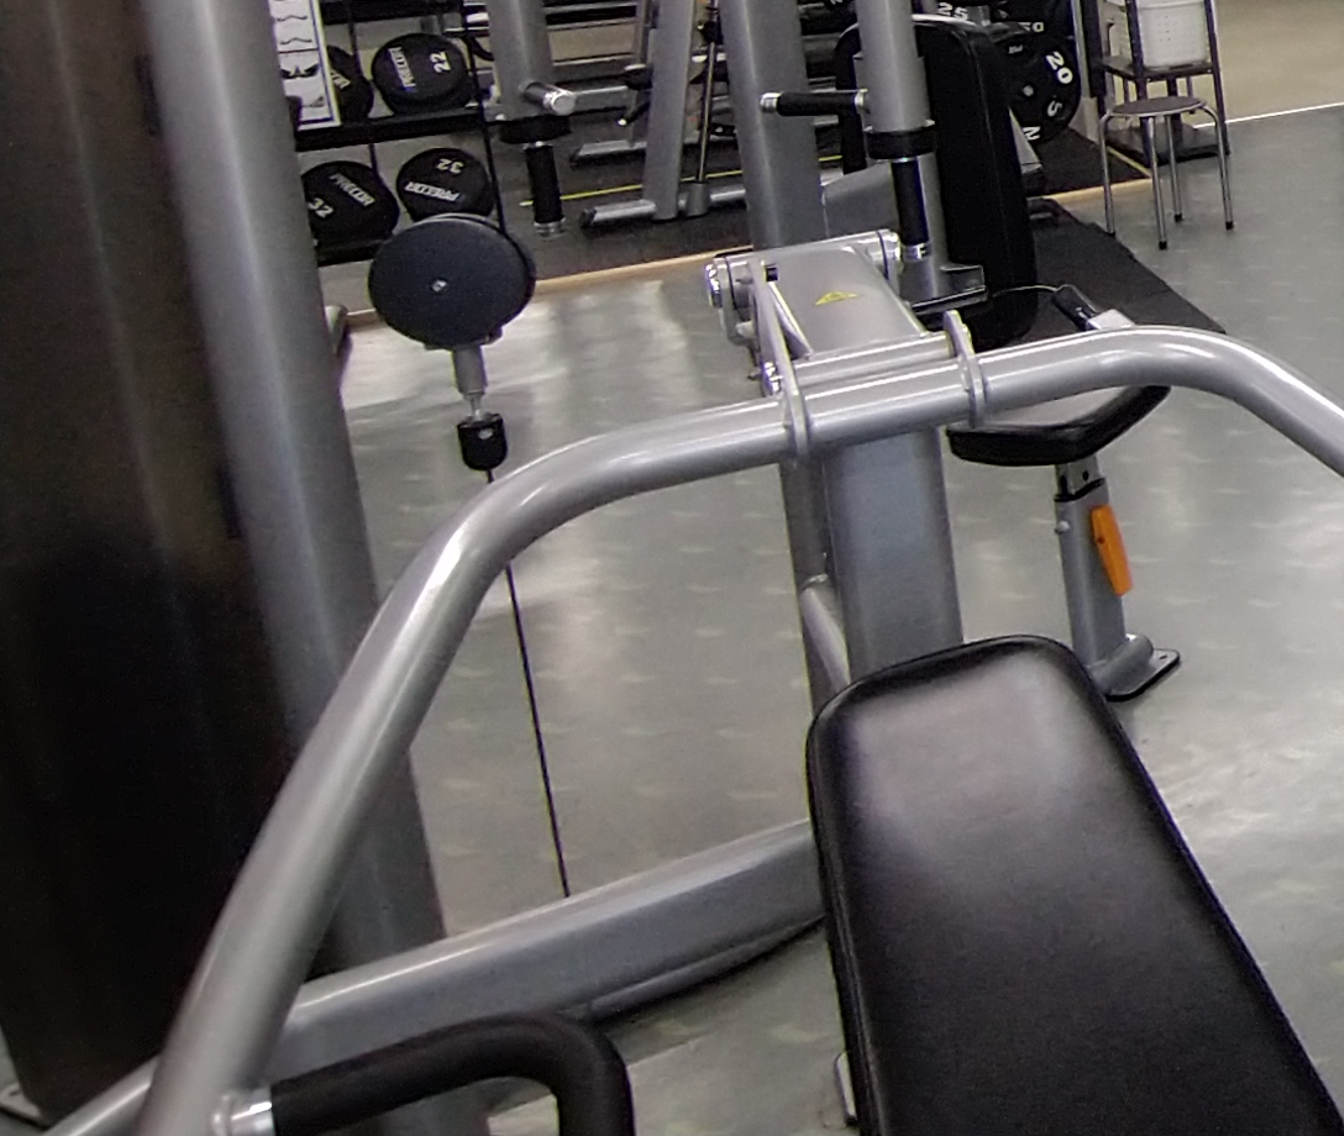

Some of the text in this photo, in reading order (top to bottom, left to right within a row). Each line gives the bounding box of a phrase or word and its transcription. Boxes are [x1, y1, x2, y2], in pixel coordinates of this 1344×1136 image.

[937, 1, 969, 21] 25
[428, 48, 453, 74] 22
[1045, 50, 1074, 85] 20
[436, 157, 465, 174] 32
[307, 197, 335, 219] 32
